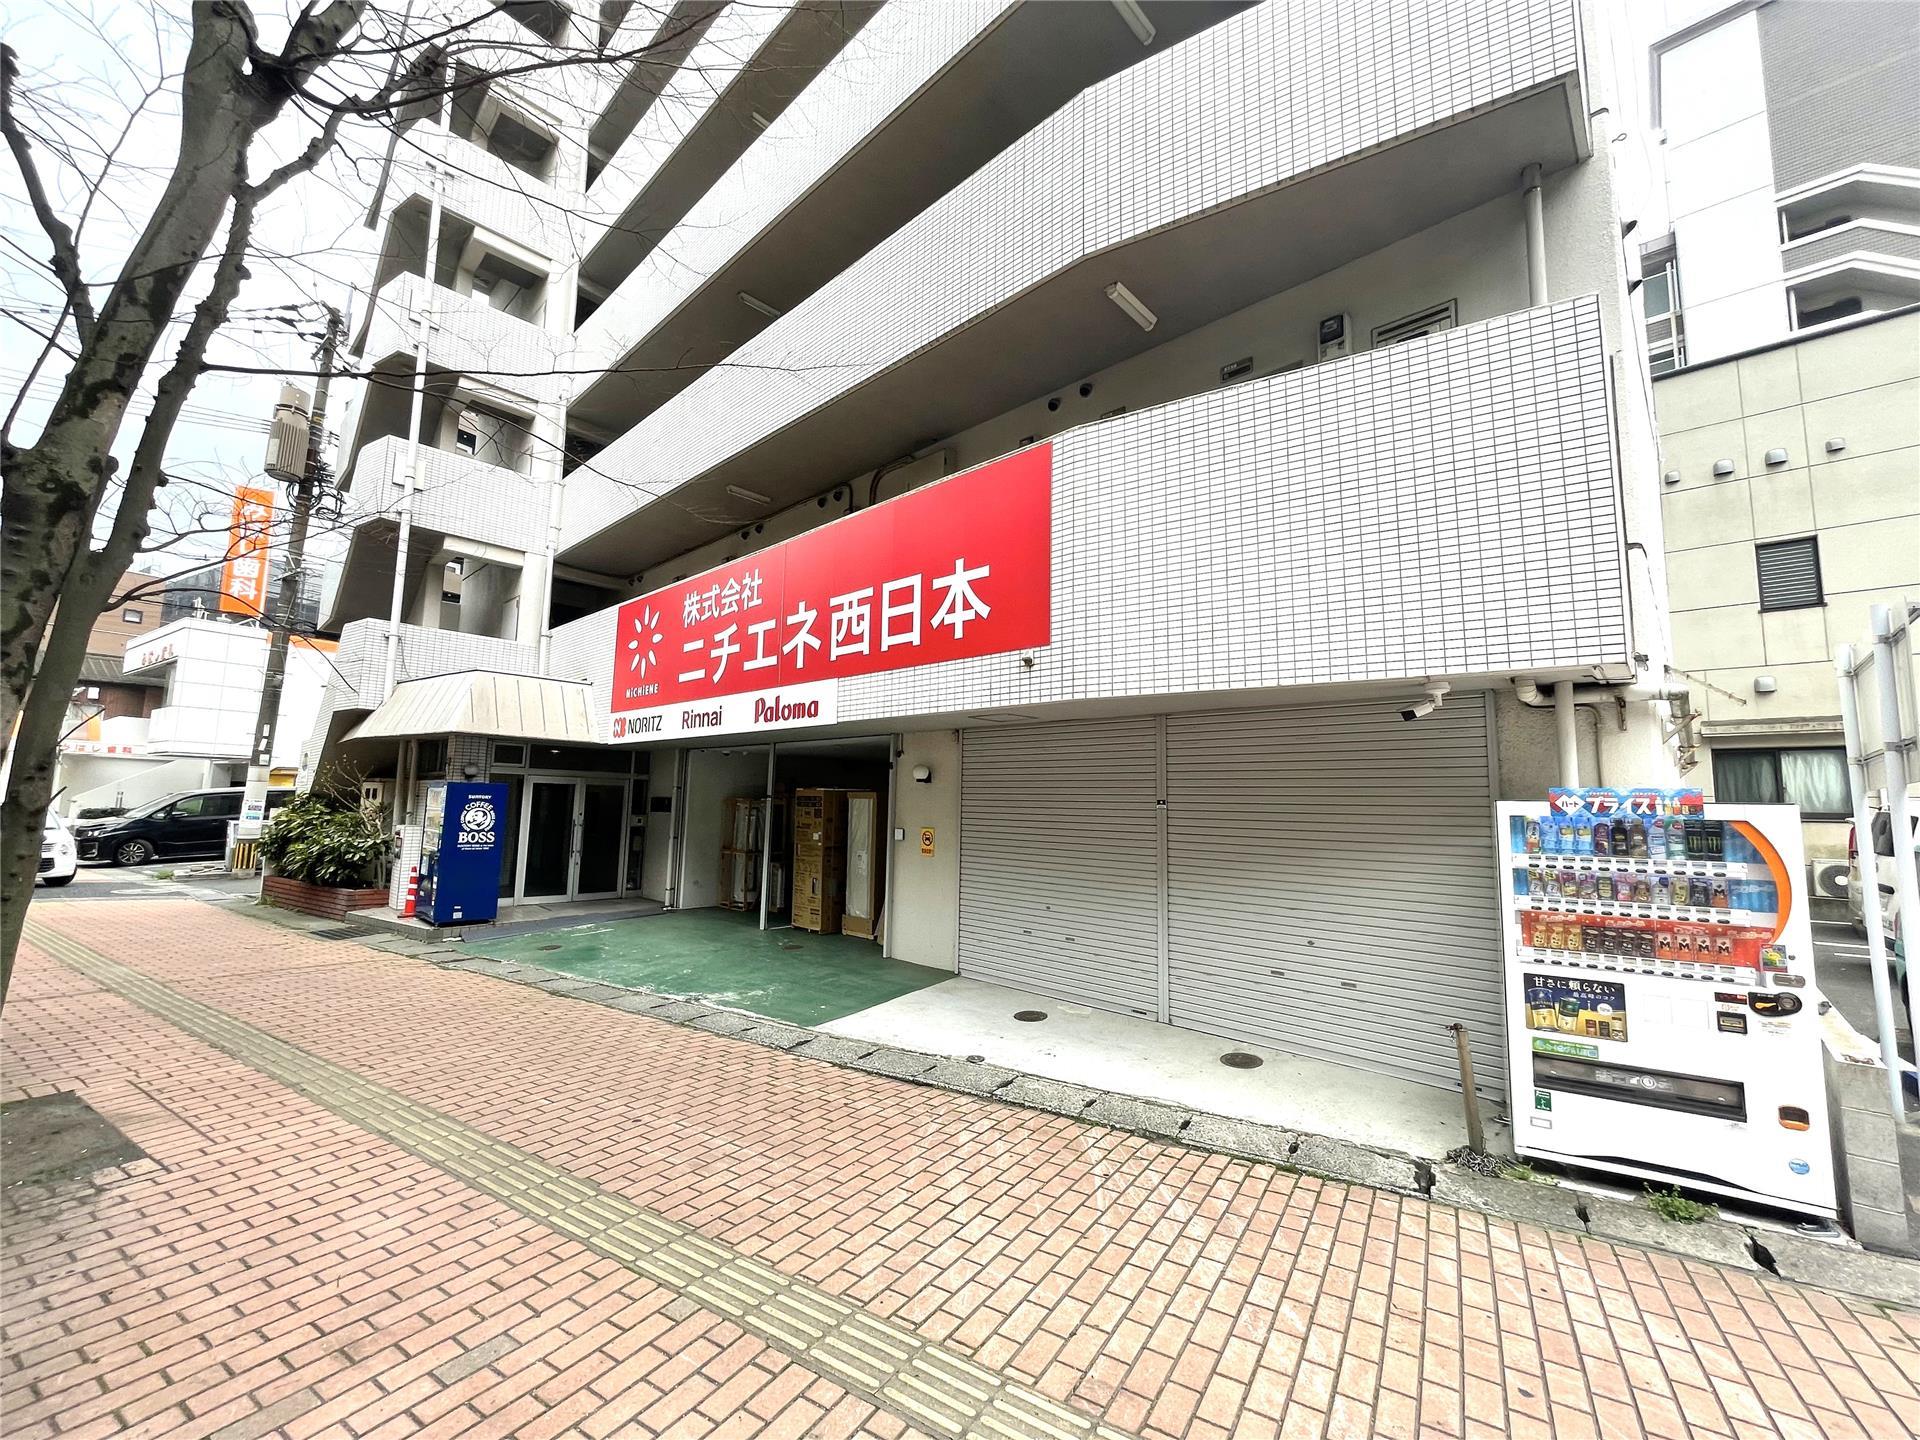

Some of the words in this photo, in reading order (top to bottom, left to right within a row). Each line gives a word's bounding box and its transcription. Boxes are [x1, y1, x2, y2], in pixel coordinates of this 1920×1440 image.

[682, 568, 764, 627] 株式会社
[677, 557, 991, 684] ニチエネ西日本
[681, 705, 723, 730] Rinnai
[754, 695, 819, 724] Paloma
[627, 715, 663, 734] NORITZ
[465, 801, 493, 810] COFFEE
[1586, 796, 1652, 815] プライス
[458, 831, 495, 843] BOSS
[1533, 976, 1616, 994] 甘さに頼らない
